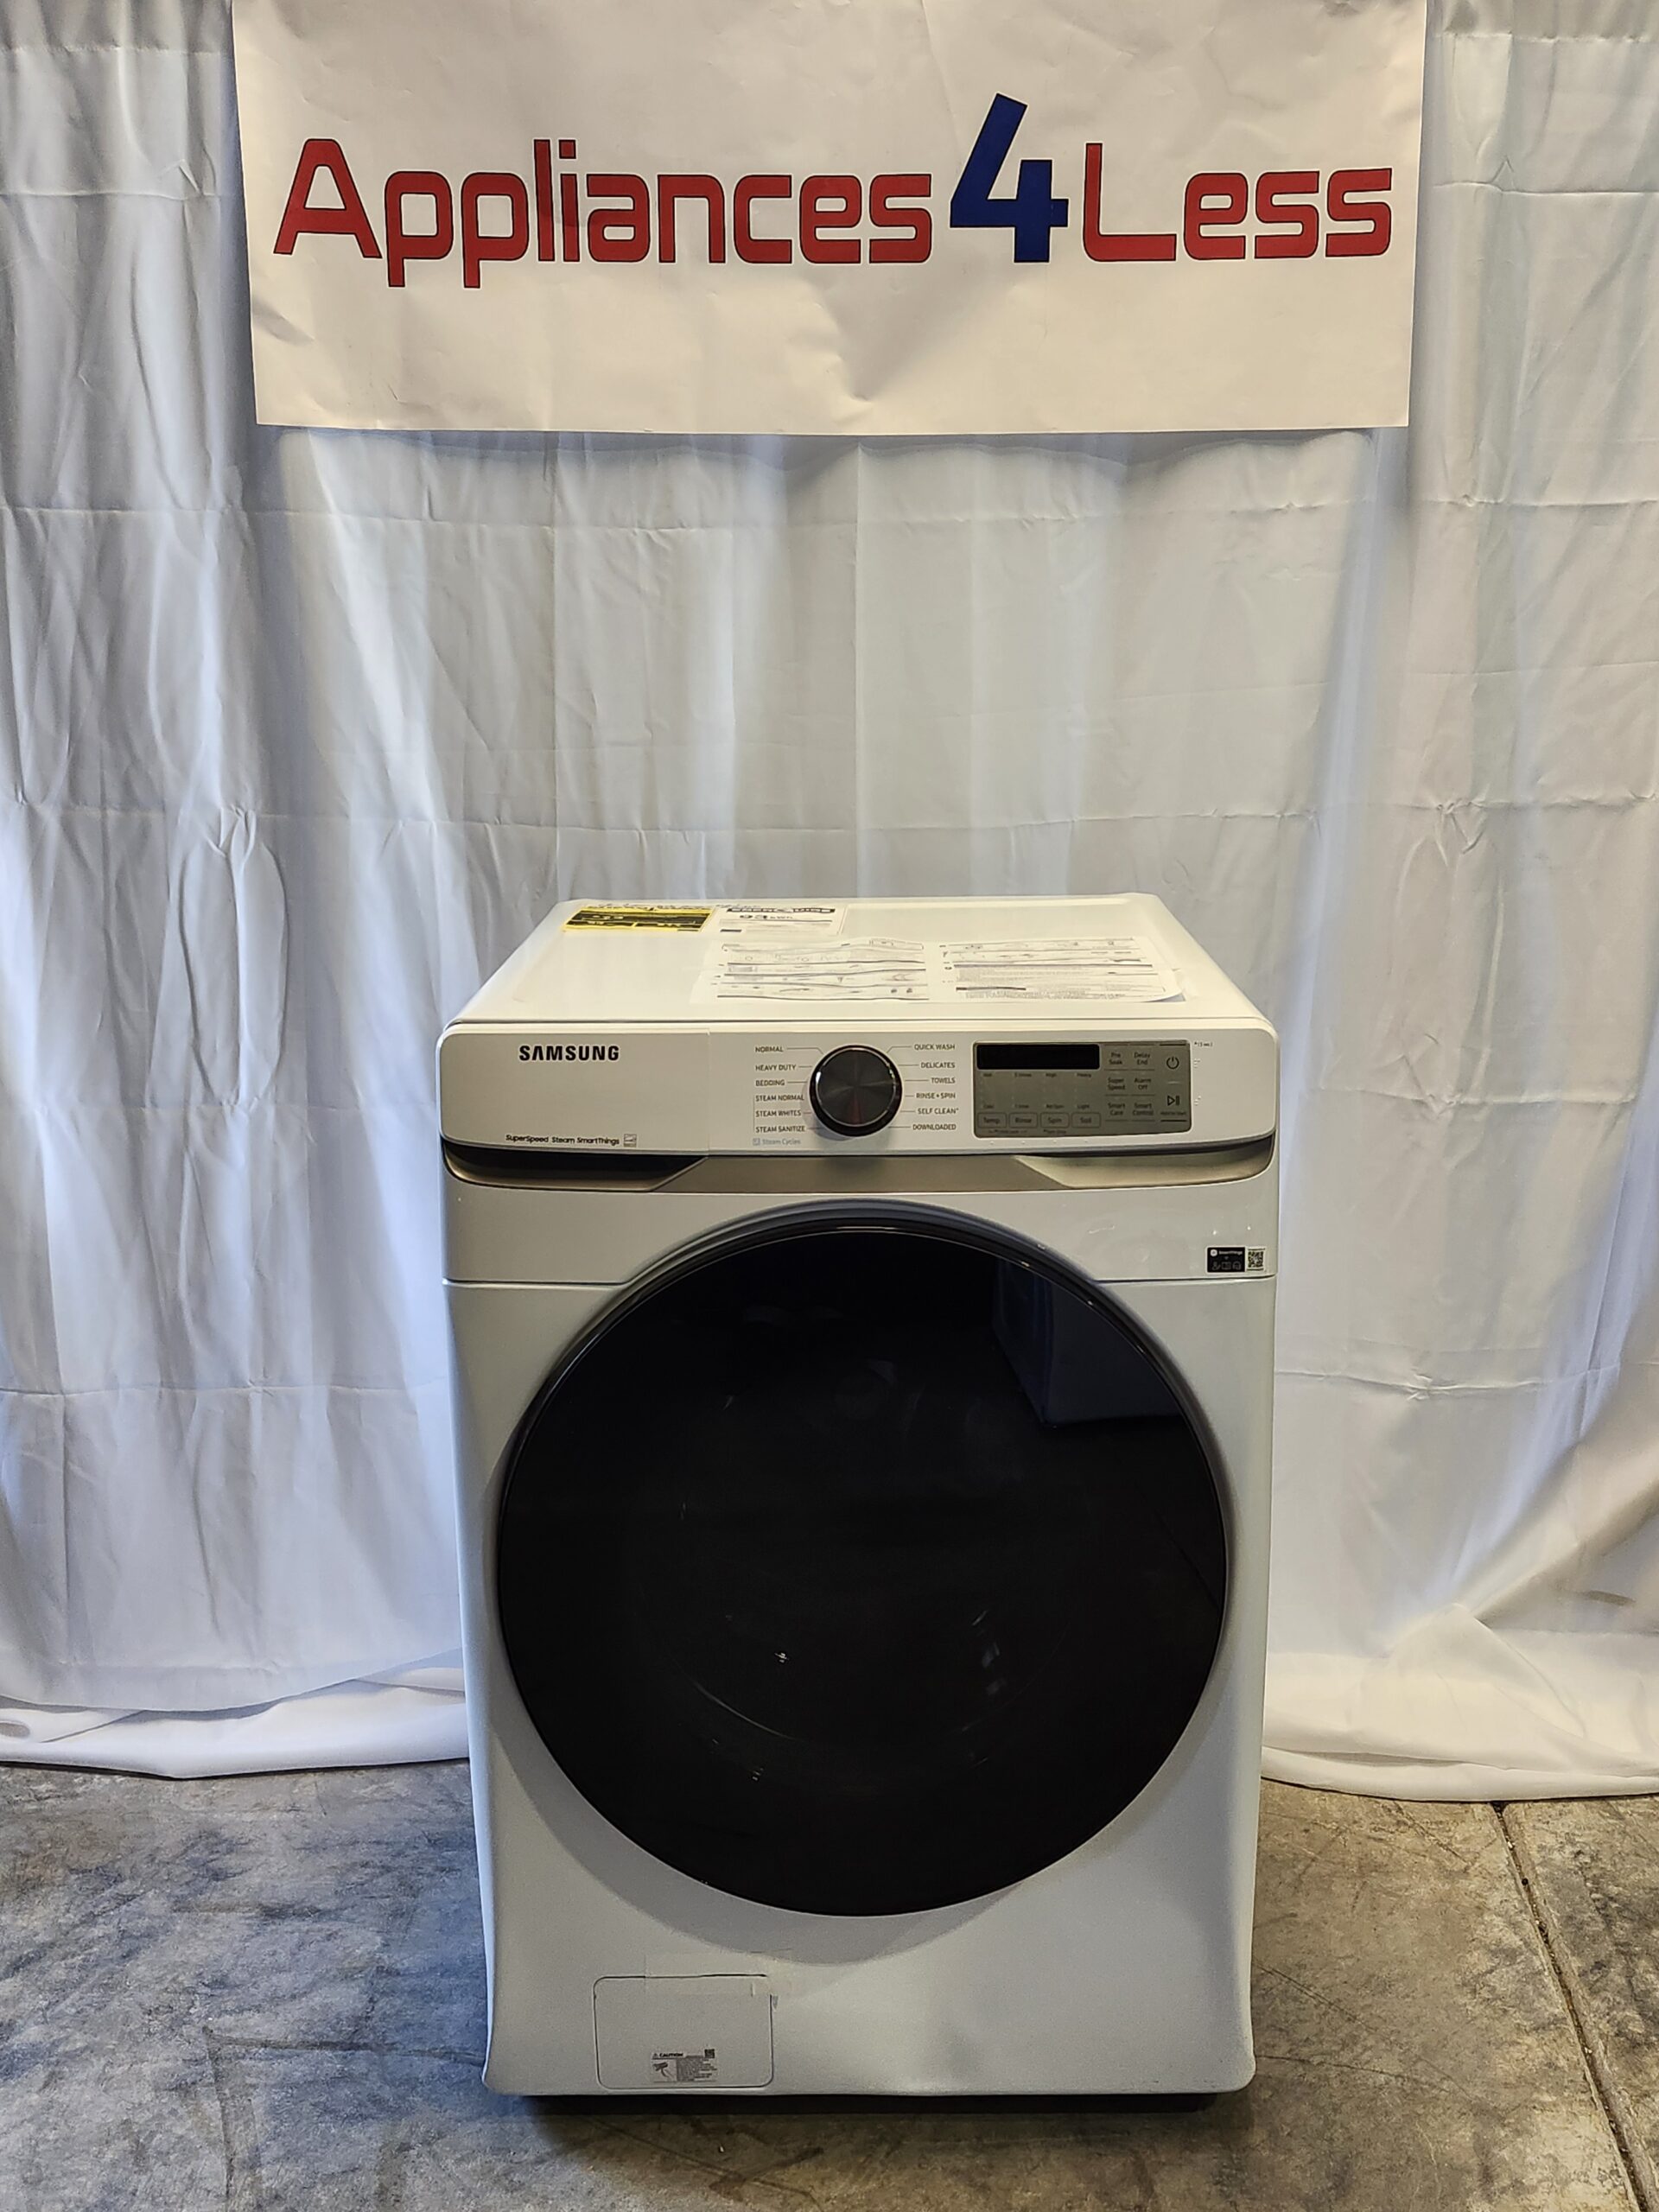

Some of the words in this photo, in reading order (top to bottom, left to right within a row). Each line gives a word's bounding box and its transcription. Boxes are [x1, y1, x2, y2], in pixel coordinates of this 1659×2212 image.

[518, 1045, 620, 1061] SAMSUNG
[505, 1135, 550, 1143] SuperSpeed
[576, 1136, 620, 1146] SmartThings
